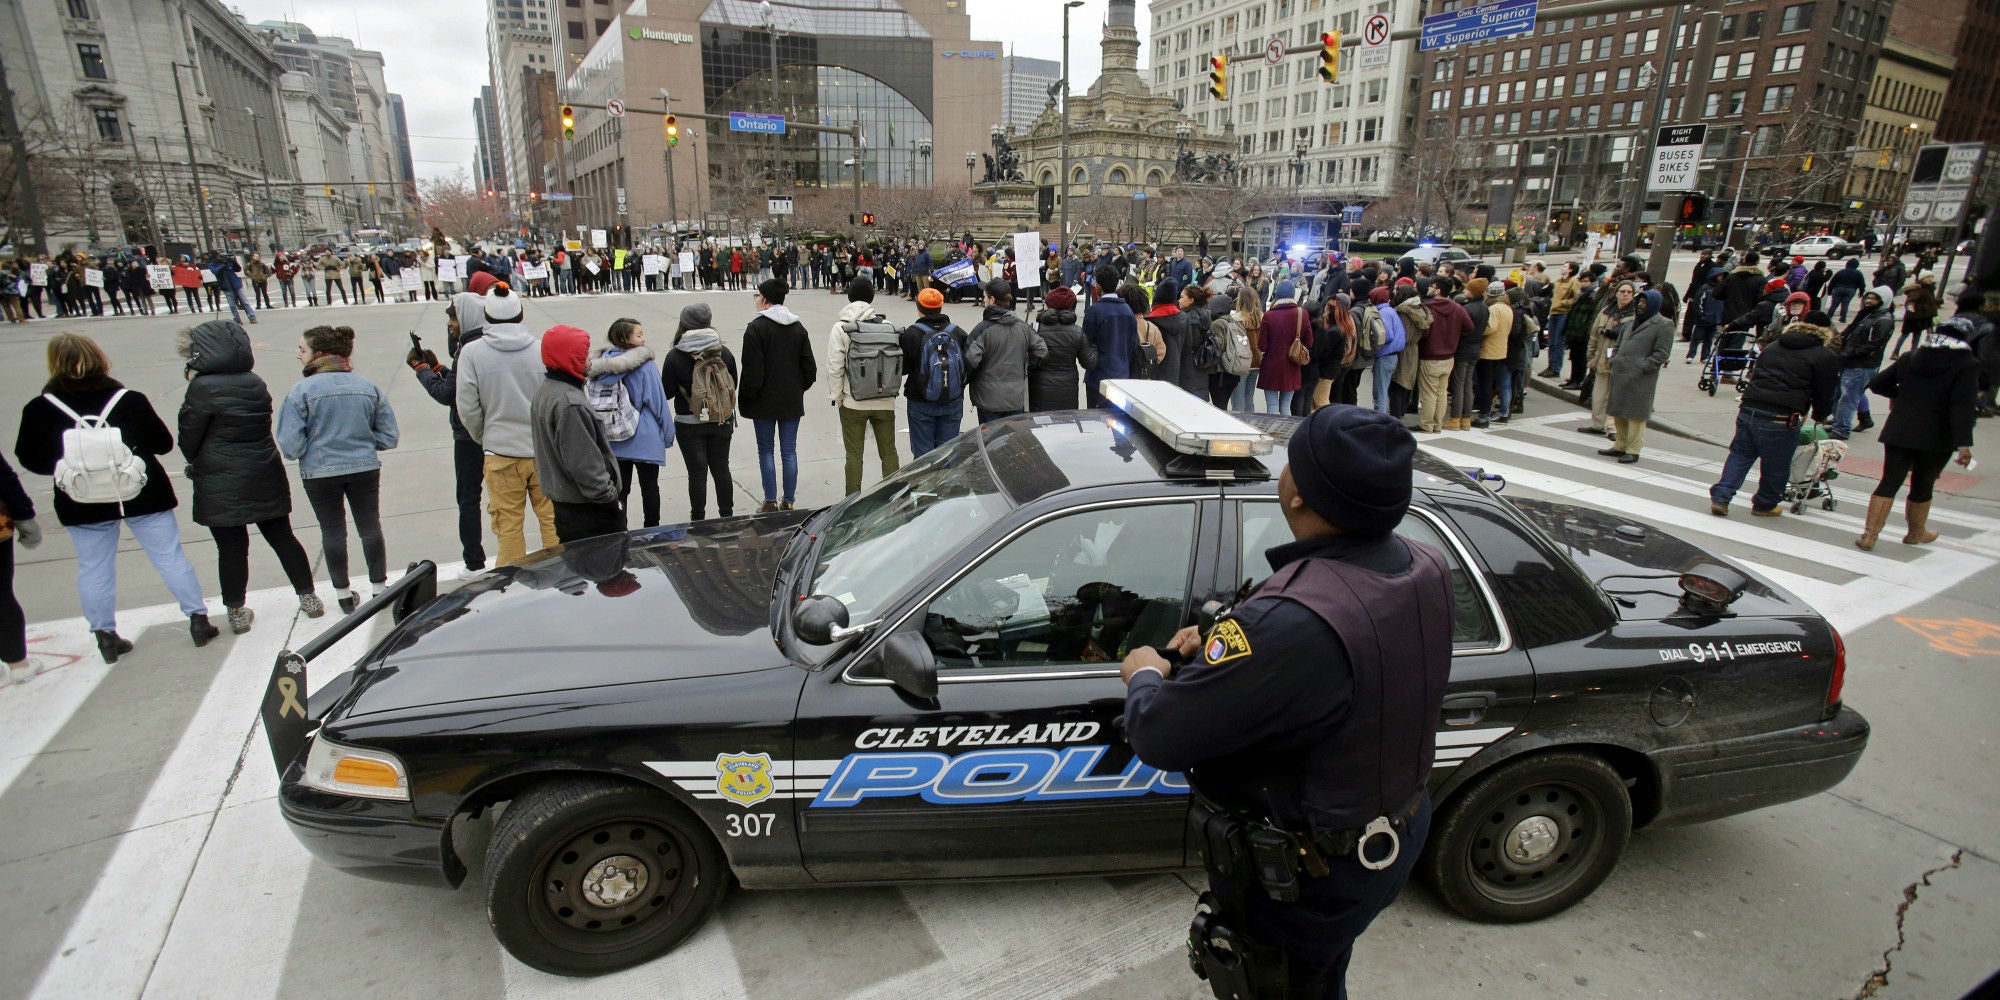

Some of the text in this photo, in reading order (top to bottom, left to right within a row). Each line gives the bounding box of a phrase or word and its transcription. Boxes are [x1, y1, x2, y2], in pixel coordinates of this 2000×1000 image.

[1457, 4, 1500, 18] Civic Center
[1481, 7, 1531, 25] Superior
[642, 27, 693, 44] Huntington
[1426, 28, 1491, 47] W. Superior
[960, 49, 997, 60] CLIFFS
[737, 118, 777, 131] Ontario
[1659, 150, 1694, 160] BUSES
[1659, 162, 1689, 172] BIKES
[1658, 175, 1685, 184] ONLY
[1912, 207, 1920, 216] 8
[1658, 640, 1803, 663] DIAL 9-1-1 EMERGENCY
[855, 721, 1101, 749] CLEVELAND
[728, 761, 760, 769] CLEVELAND
[810, 744, 1190, 807] POLI
[725, 813, 776, 837] 307
